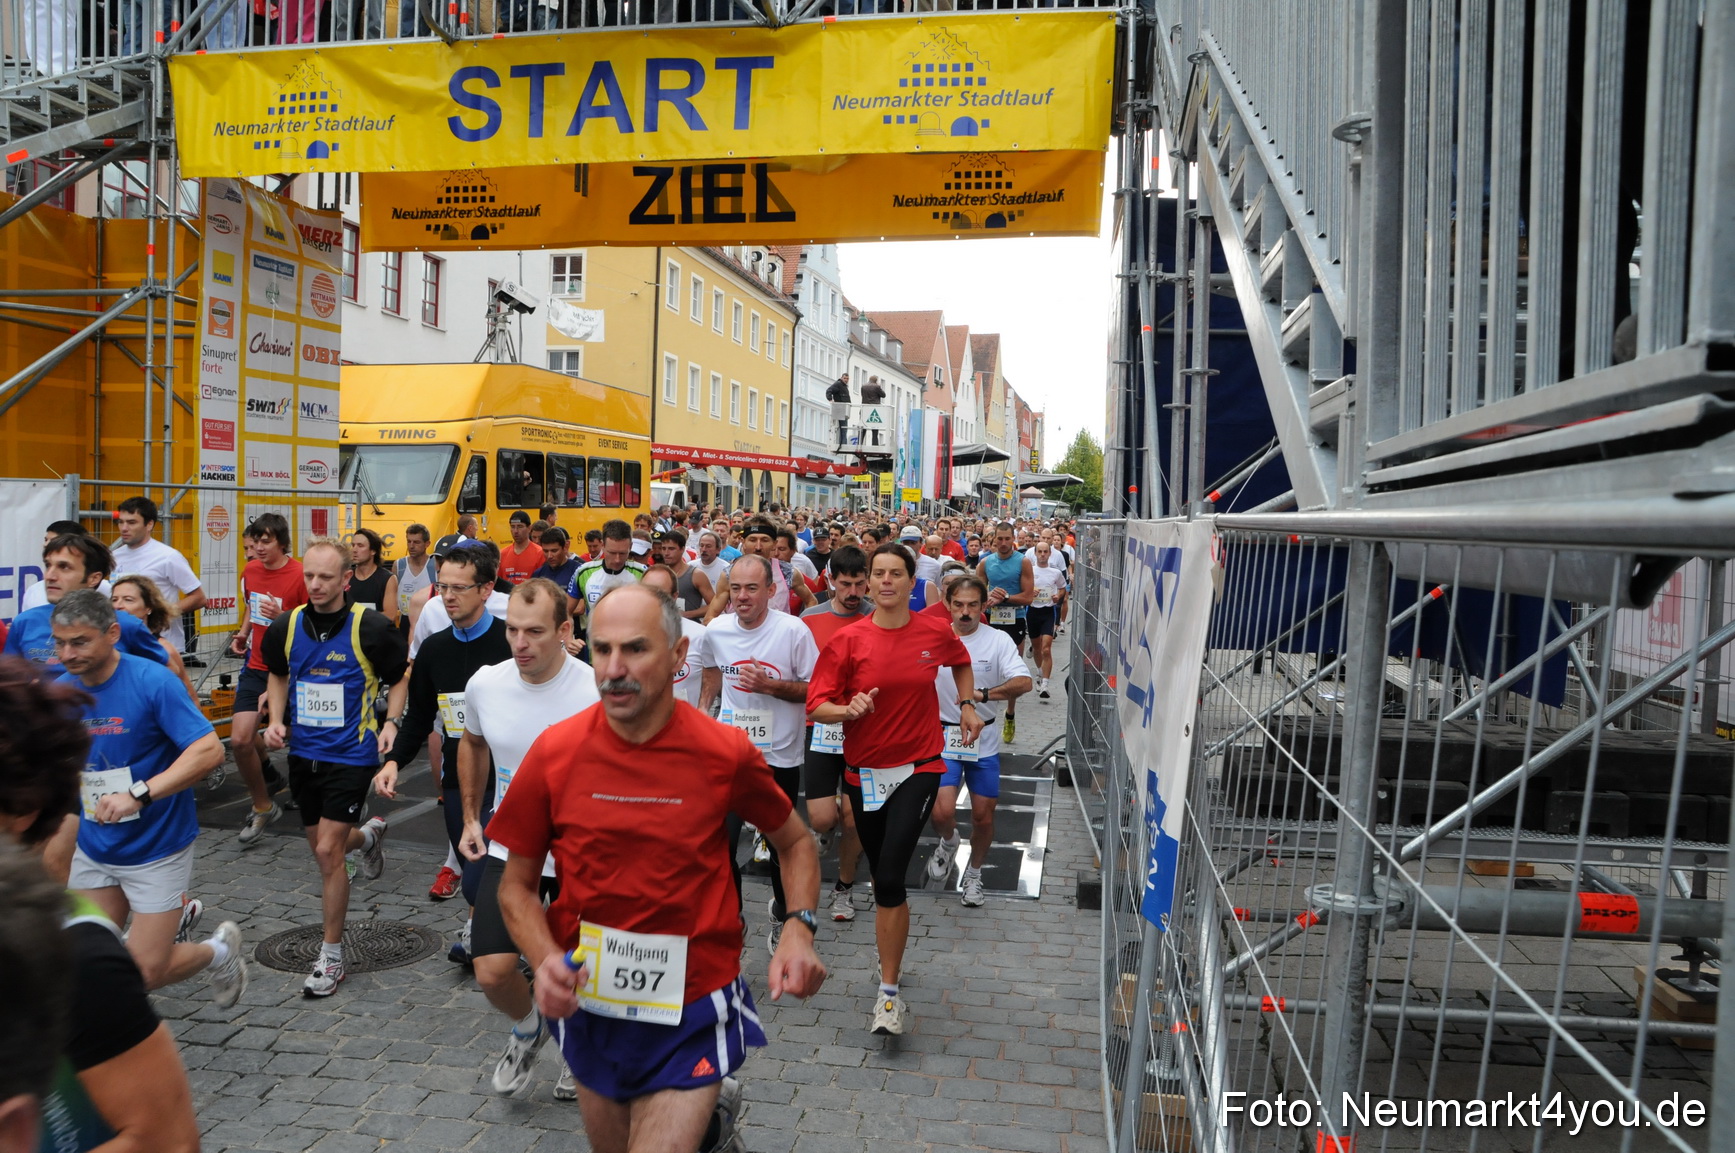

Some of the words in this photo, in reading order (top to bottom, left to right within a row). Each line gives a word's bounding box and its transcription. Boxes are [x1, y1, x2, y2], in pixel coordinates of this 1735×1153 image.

[447, 56, 775, 142] START
[832, 90, 953, 111] Neumarkter
[958, 87, 1055, 107] Stadtlauf
[213, 118, 310, 137] Neumarkter
[314, 114, 396, 132] Stadtlauf
[629, 163, 797, 225] ZIEL
[892, 192, 986, 208] Neumarkter
[991, 189, 1065, 206] Stadtlauf
[391, 206, 472, 220] Neumarkter
[476, 203, 542, 218] Stadtlauf
[298, 223, 343, 247] MERZ
[213, 272, 232, 284] KANN
[310, 291, 336, 304] WITTMANN
[202, 344, 237, 362] Sinupret
[302, 344, 340, 365] OBI
[201, 360, 223, 374] forte
[212, 386, 237, 397] Egner
[246, 398, 276, 414] swn
[300, 401, 328, 418] MCM
[378, 429, 437, 439] TIMING
[521, 426, 552, 440] SPORTRONIC
[598, 438, 612, 449] EVENT
[612, 441, 628, 451] SERVICE
[665, 448, 689, 456] Service
[725, 454, 758, 463] Serviceline:
[275, 470, 290, 479] BÖGL
[298, 464, 323, 472] GERHART
[310, 471, 327, 479] JANIG
[201, 472, 236, 482] HACKNER
[206, 597, 236, 609] MERZ
[999, 611, 1012, 619] 928
[307, 687, 320, 698] Jörg
[307, 700, 338, 712] 3055
[735, 713, 760, 722] Andreas
[736, 726, 766, 737] 415
[606, 936, 669, 964] Wolfgang
[613, 967, 666, 993] 597
